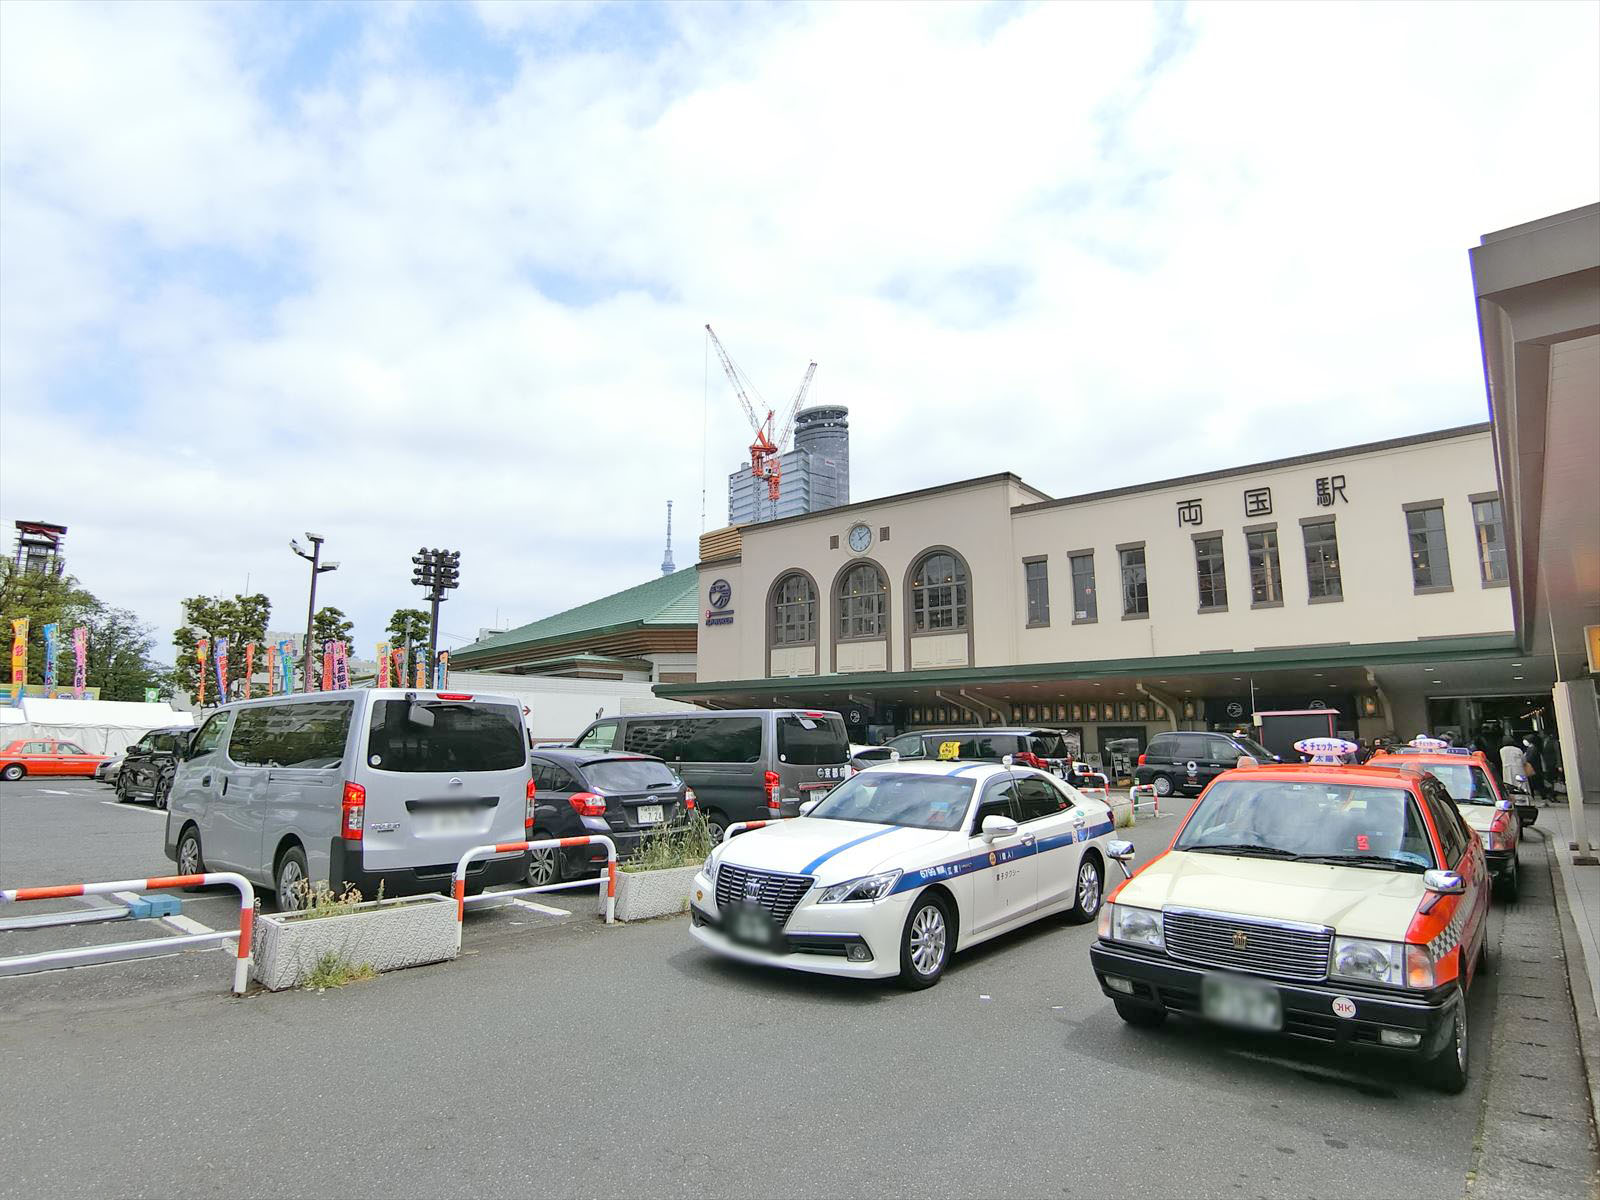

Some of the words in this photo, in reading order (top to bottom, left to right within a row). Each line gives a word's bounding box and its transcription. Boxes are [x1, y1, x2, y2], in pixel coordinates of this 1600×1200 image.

[1176, 475, 1349, 528] 両国駅
[1309, 742, 1338, 752] チェッカー
